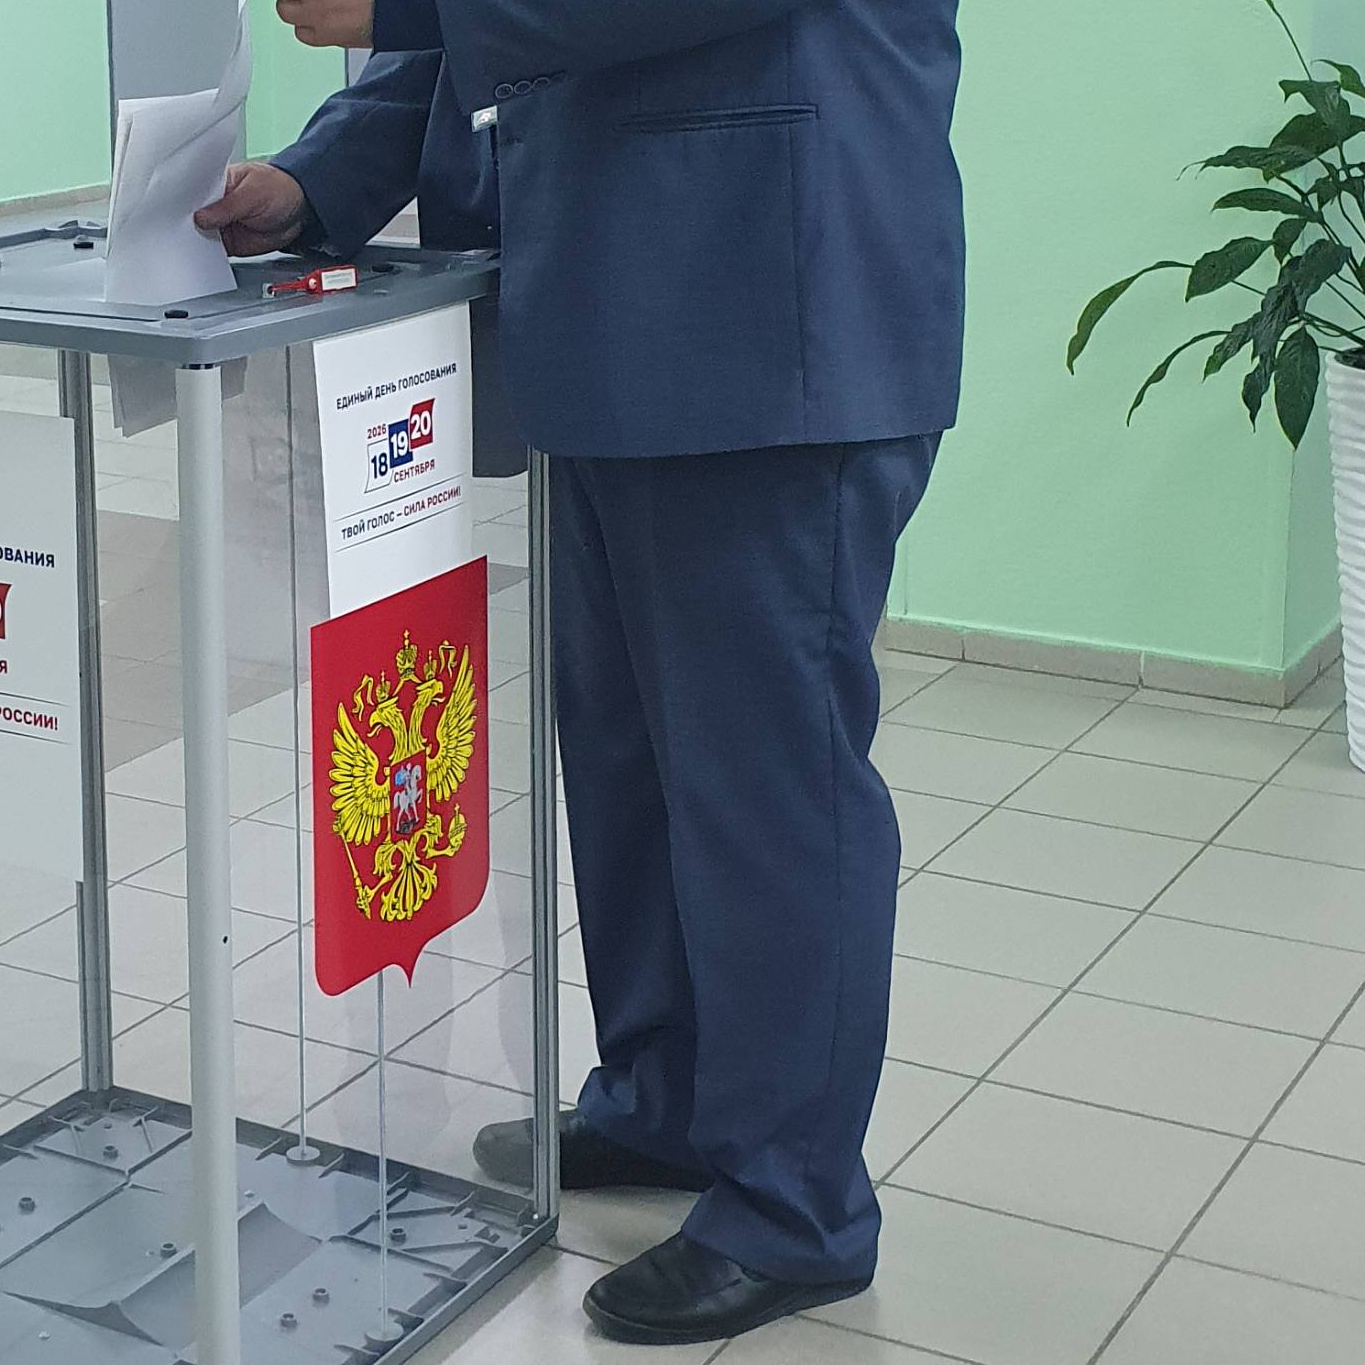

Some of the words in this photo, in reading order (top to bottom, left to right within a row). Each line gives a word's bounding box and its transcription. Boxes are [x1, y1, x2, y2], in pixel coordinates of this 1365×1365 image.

[336, 385, 373, 410] ЕДИНЫЙ
[374, 383, 397, 400] ДЕНЬ
[398, 363, 457, 391] ГОЛОСОВАНИЯ
[367, 423, 387, 439] 2026
[410, 410, 432, 440] 20
[390, 431, 409, 459] 19
[371, 452, 388, 479] 18
[393, 459, 435, 483] СЕНТЯБРЯ
[341, 518, 366, 540] ТВОЙ
[367, 510, 395, 531] ГОЛОС
[403, 498, 426, 518] СИЛА
[427, 485, 461, 509] РОССИИ!
